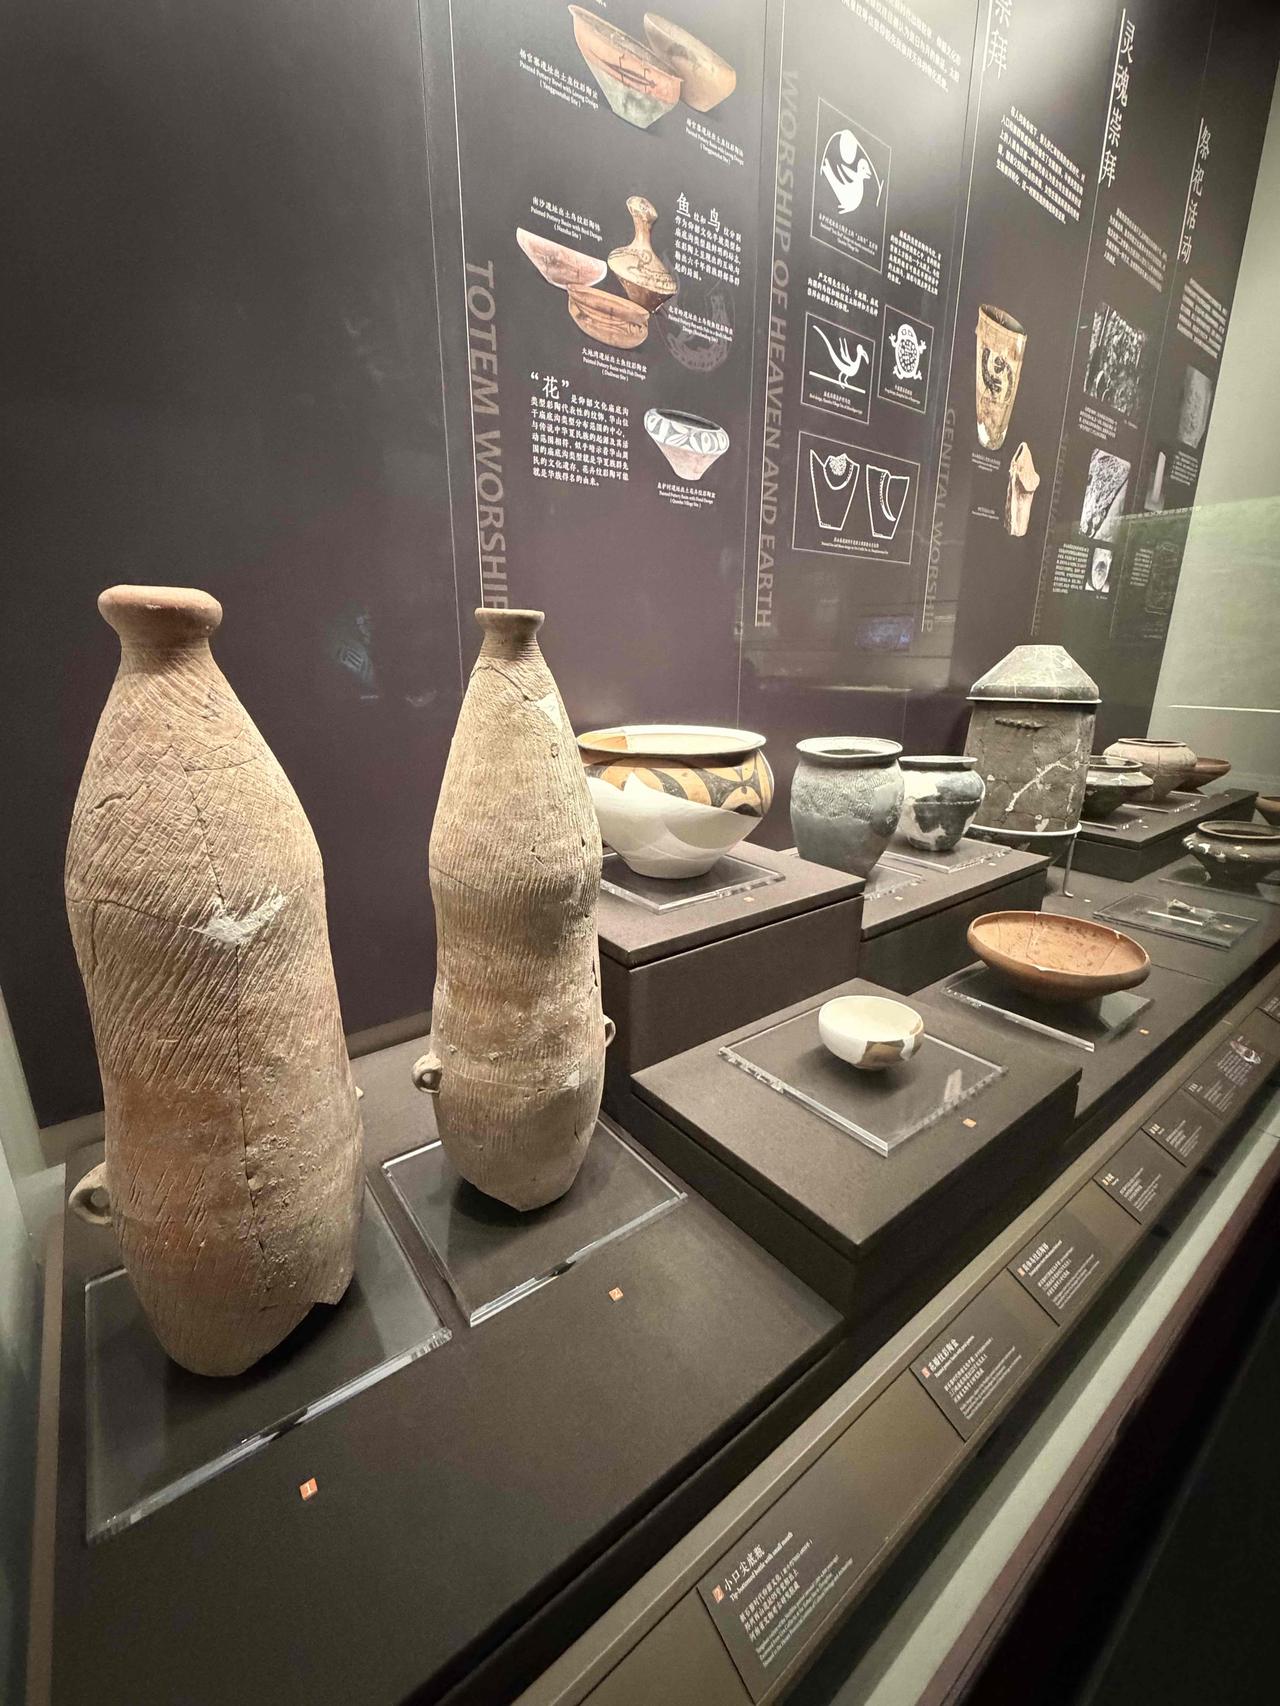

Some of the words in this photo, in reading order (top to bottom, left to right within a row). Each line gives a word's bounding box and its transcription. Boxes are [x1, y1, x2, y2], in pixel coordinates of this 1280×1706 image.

[1101, 20, 1135, 188] 灵魂崇拜
[777, 70, 798, 252] WORSHIP
[466, 260, 500, 415] TOTEM
[771, 259, 789, 310] OF
[765, 315, 786, 449] HEAVEN
[762, 456, 779, 525] AND
[936, 408, 955, 508] GENITAL
[475, 429, 508, 610] WORSHIP
[757, 534, 775, 627] EARTH
[925, 521, 943, 632] WORSHIP
[724, 1544, 765, 1591] 小口尖底瓶
